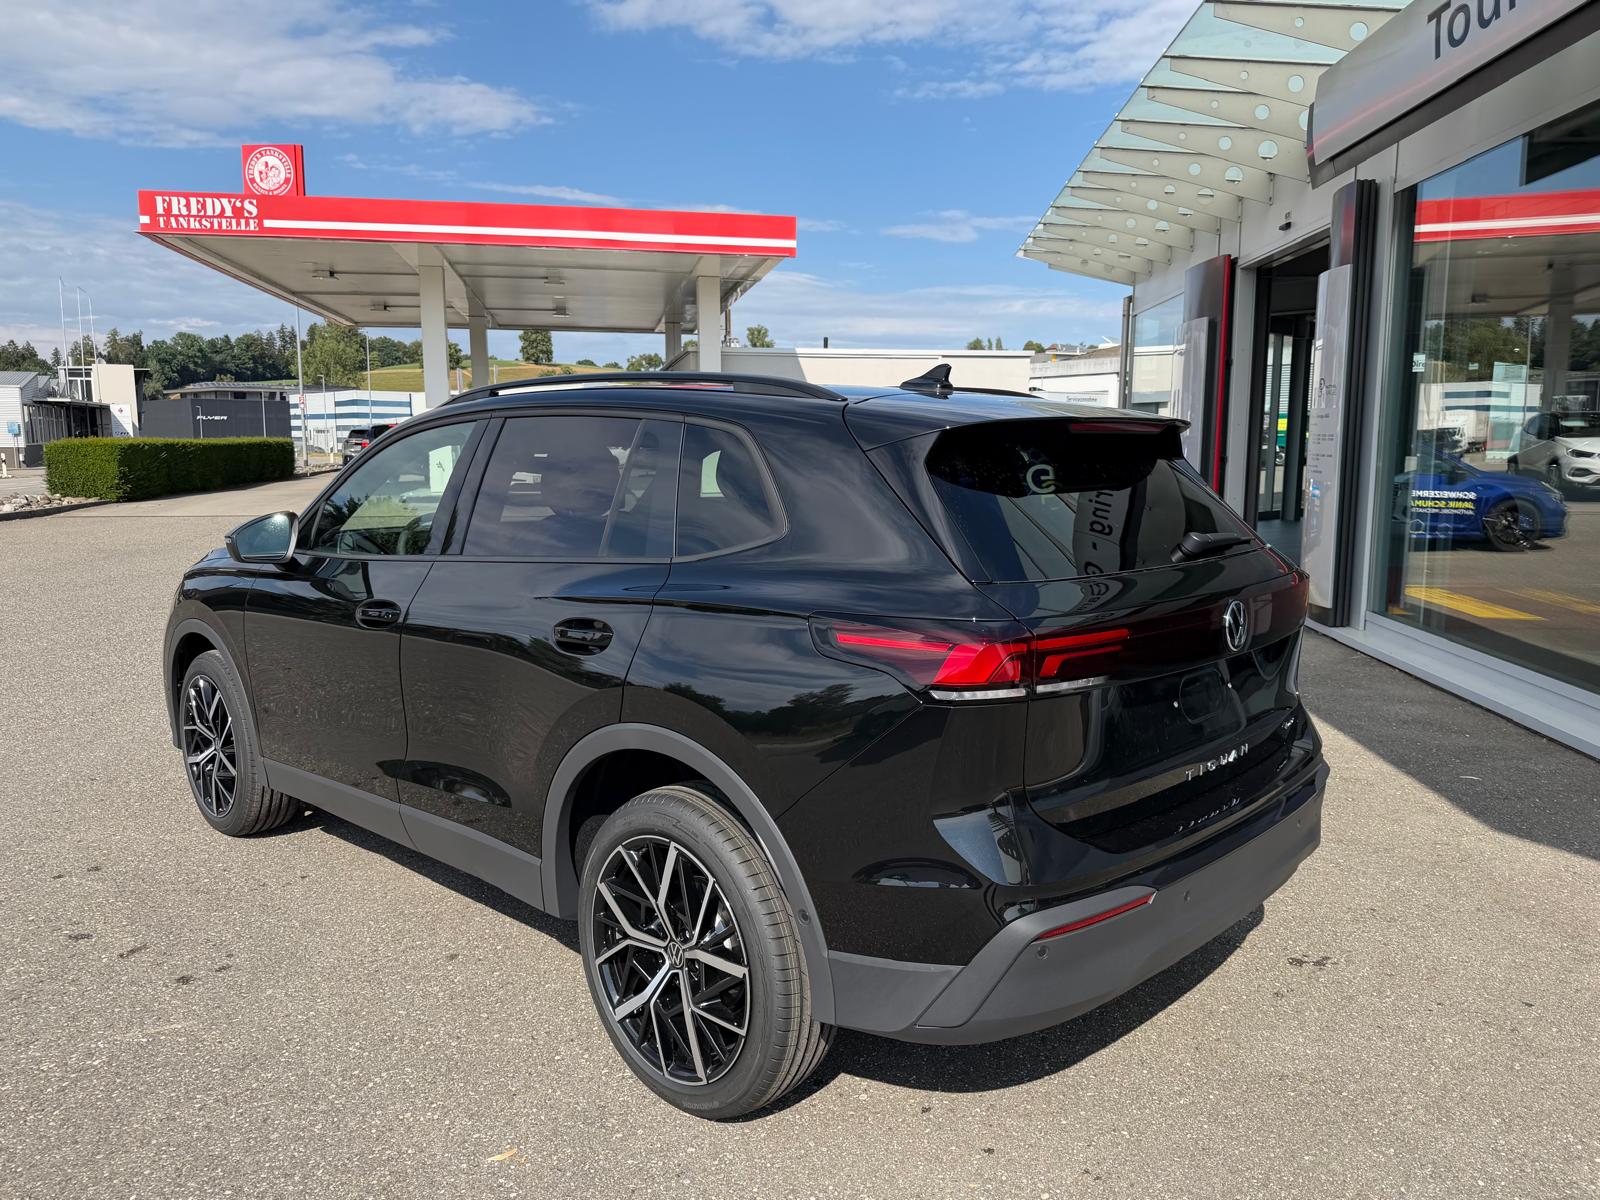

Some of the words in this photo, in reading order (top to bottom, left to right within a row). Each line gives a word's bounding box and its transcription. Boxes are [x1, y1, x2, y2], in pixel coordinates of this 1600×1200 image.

[1427, 0, 1517, 60] Tou
[155, 196, 258, 218] FREDY'S
[157, 217, 259, 231] TANKSTELLE
[1185, 743, 1249, 781] TIGUAN
